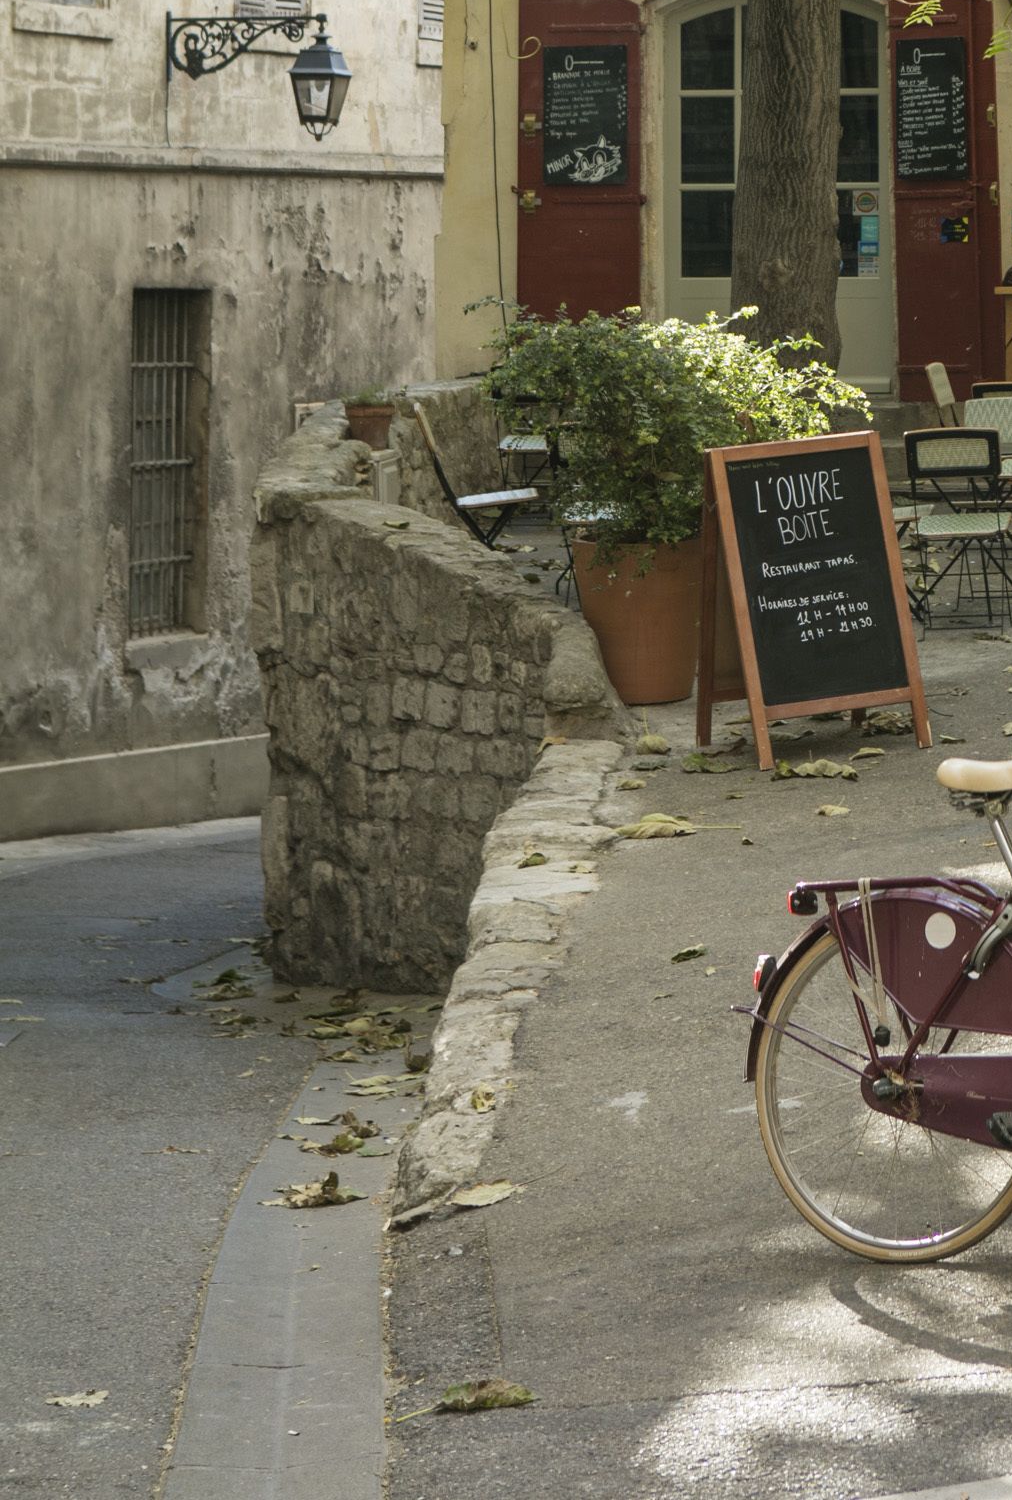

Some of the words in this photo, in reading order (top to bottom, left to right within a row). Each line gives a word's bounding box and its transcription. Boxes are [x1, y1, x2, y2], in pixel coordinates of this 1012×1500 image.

[755, 468, 844, 513] L'OUVRE
[762, 561, 821, 578] RESTAURANT
[758, 595, 797, 612] HORAIRES
[798, 597, 809, 607] DE
